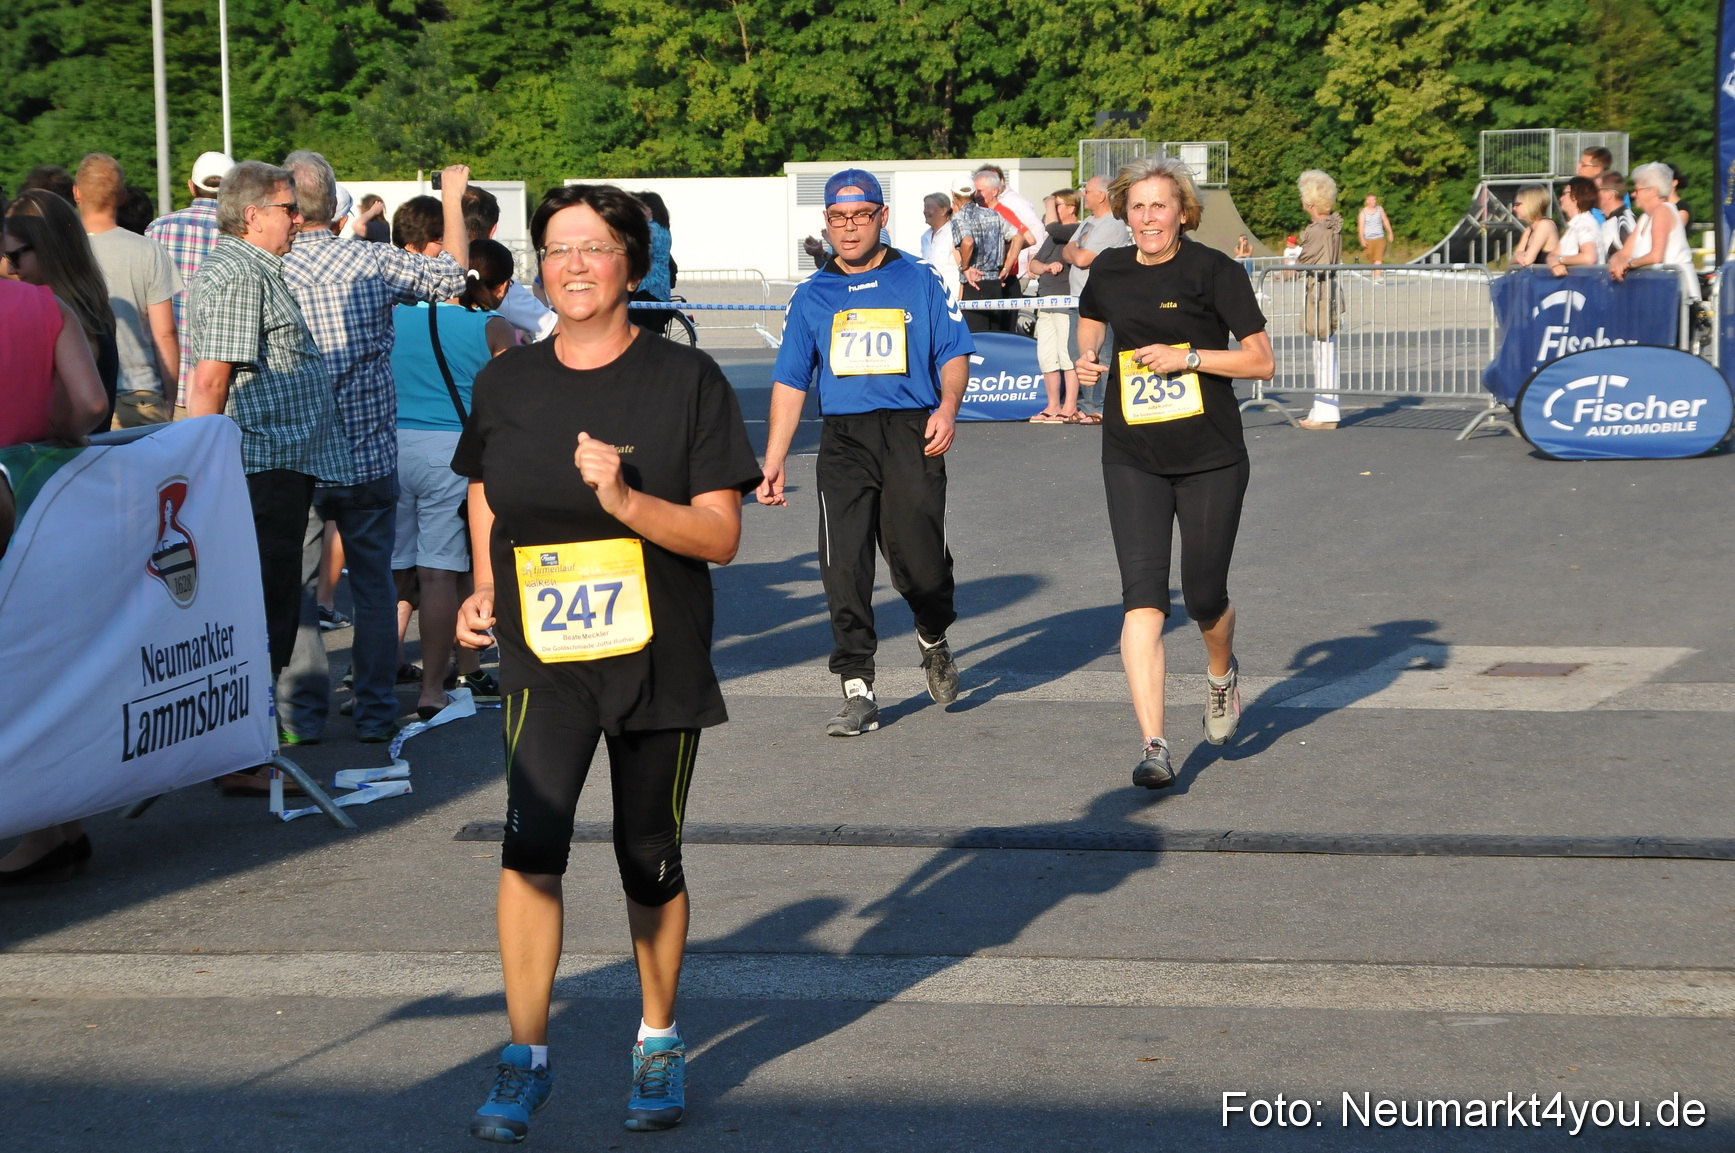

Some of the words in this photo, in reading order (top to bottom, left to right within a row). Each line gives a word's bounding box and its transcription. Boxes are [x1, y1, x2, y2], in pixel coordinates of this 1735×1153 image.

[848, 280, 878, 292] hummel
[1160, 301, 1178, 309] Jutta
[841, 332, 893, 357] 710
[1537, 326, 1638, 361] Fisch
[966, 371, 1044, 392] scher
[1131, 371, 1186, 405] 235
[962, 392, 1037, 403] UTOMOBILE
[1572, 395, 1707, 423] Fischer
[1584, 421, 1698, 437] AUTOMOBILE
[174, 573, 192, 596] 1628
[537, 581, 623, 632] 247
[140, 621, 234, 688] Neumarkter
[121, 664, 249, 763] Lammsbräu
